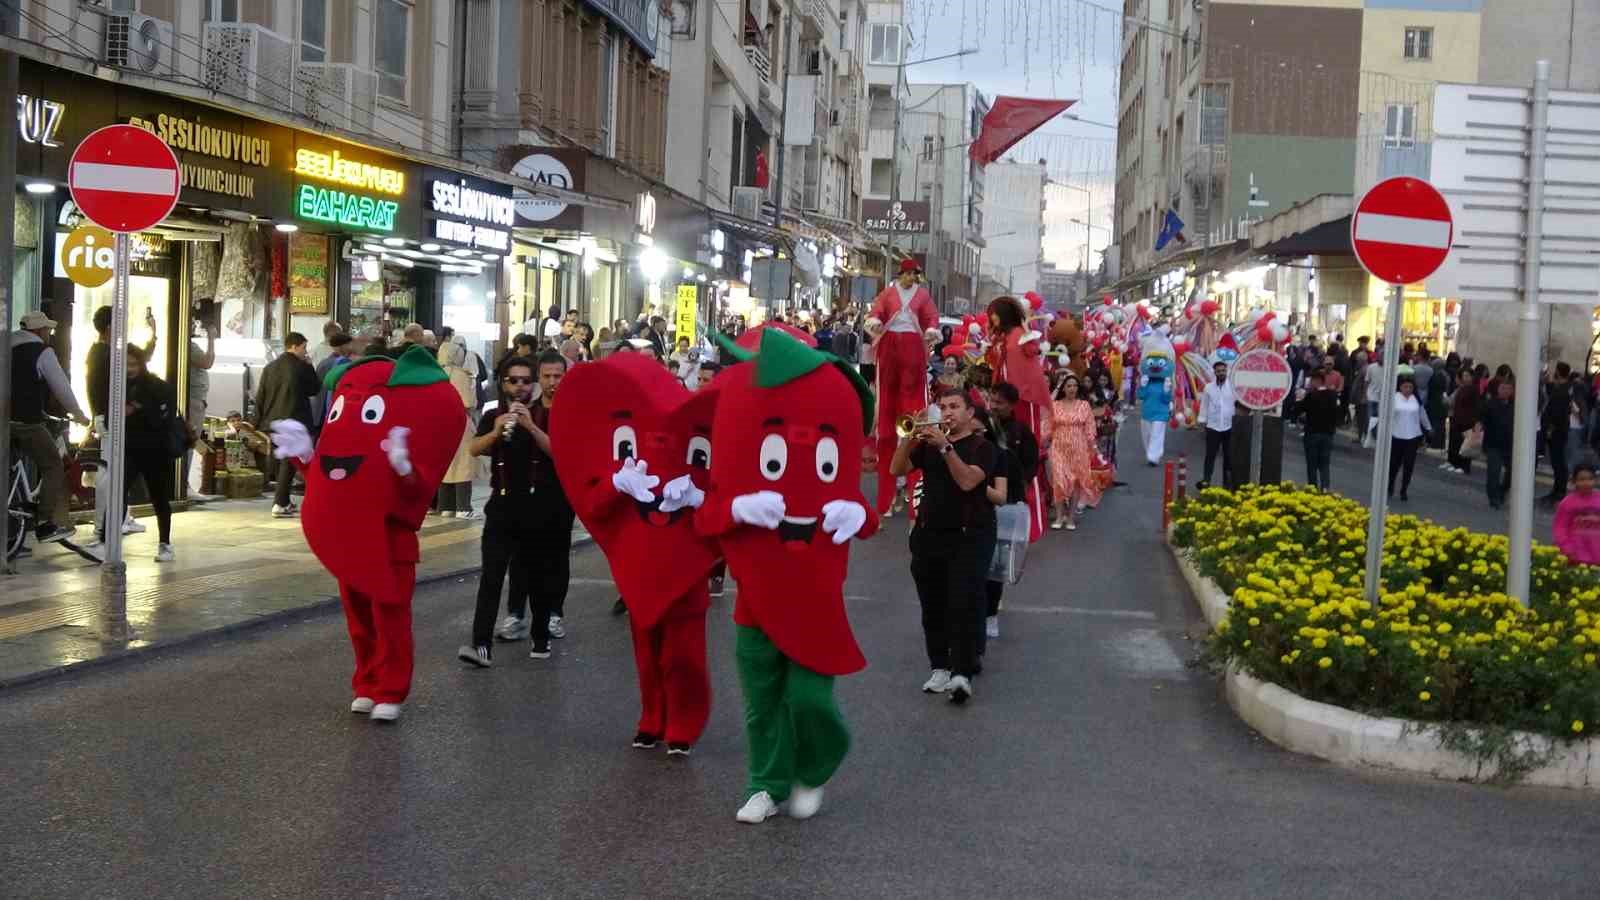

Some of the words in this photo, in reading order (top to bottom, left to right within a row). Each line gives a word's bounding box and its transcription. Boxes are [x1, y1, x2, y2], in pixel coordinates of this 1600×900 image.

[157, 113, 270, 167] SESLİOKUYUCU
[180, 163, 254, 198] UYUMCULUK
[300, 184, 398, 231] BAHARAT
[68, 234, 114, 269] ria
